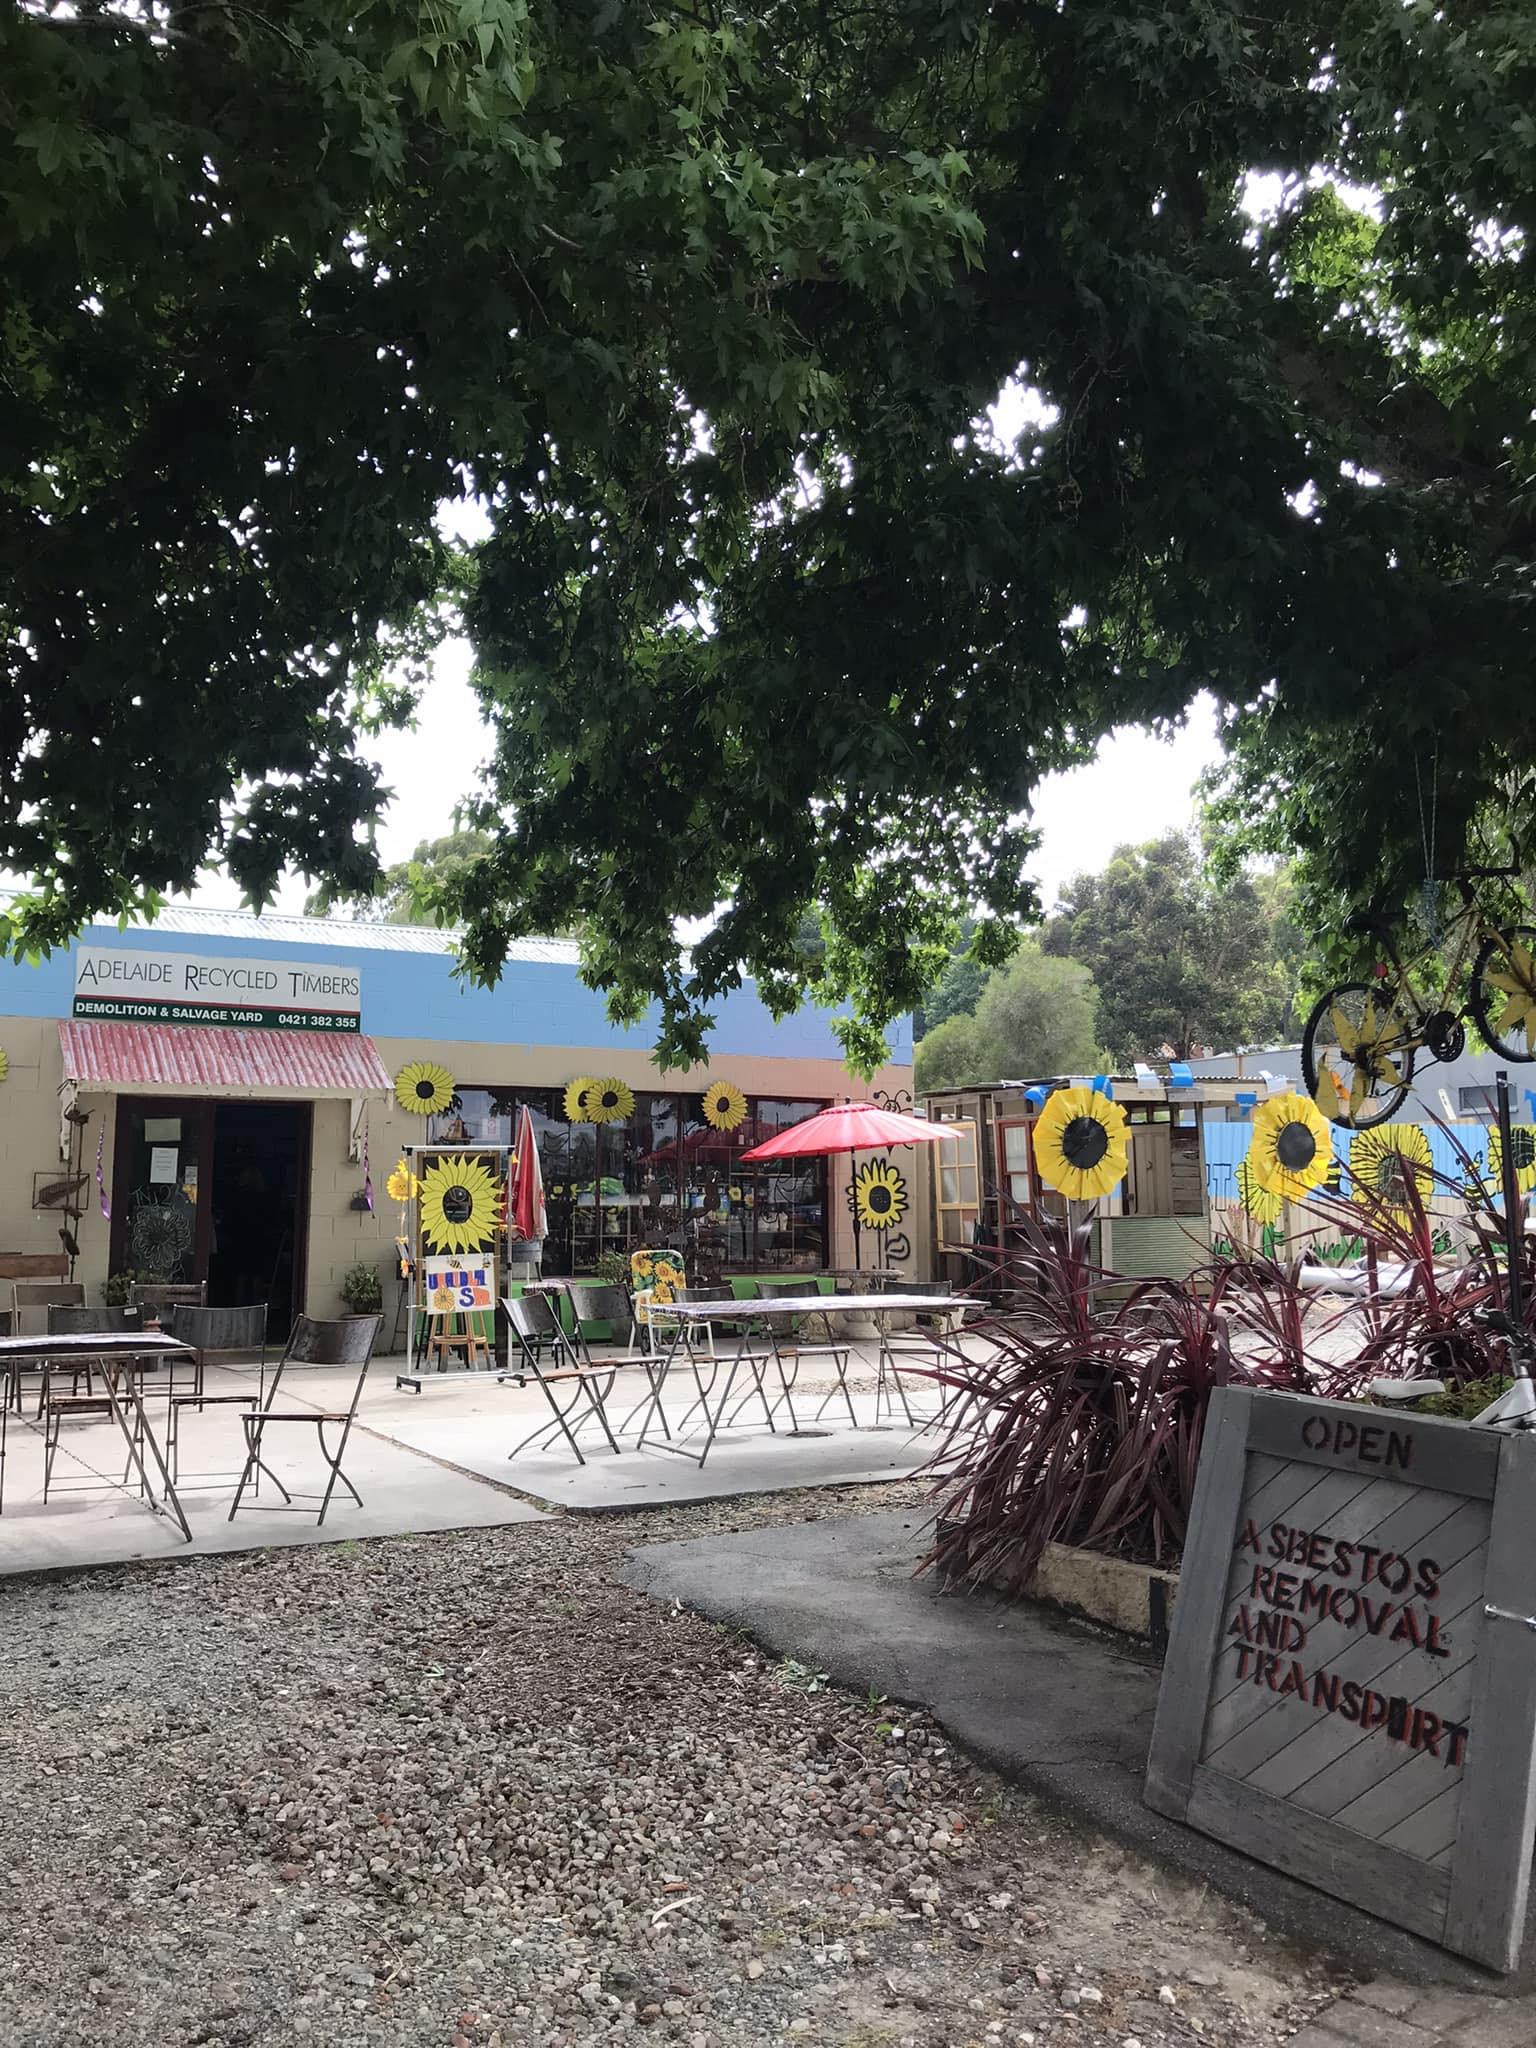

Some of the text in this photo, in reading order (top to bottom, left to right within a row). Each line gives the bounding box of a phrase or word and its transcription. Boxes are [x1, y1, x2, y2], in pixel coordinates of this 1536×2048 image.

[78, 958, 359, 998] ADELAIDE RECYCLED TIMBERS
[76, 1002, 357, 1028] DEMOLITION & SALVAGE YARD 0421 382 355
[1302, 1416, 1412, 1469] OPEN
[1233, 1518, 1441, 1600] ASBESTOS
[1227, 1604, 1307, 1652] AND
[1250, 1564, 1451, 1658] REMOVAL
